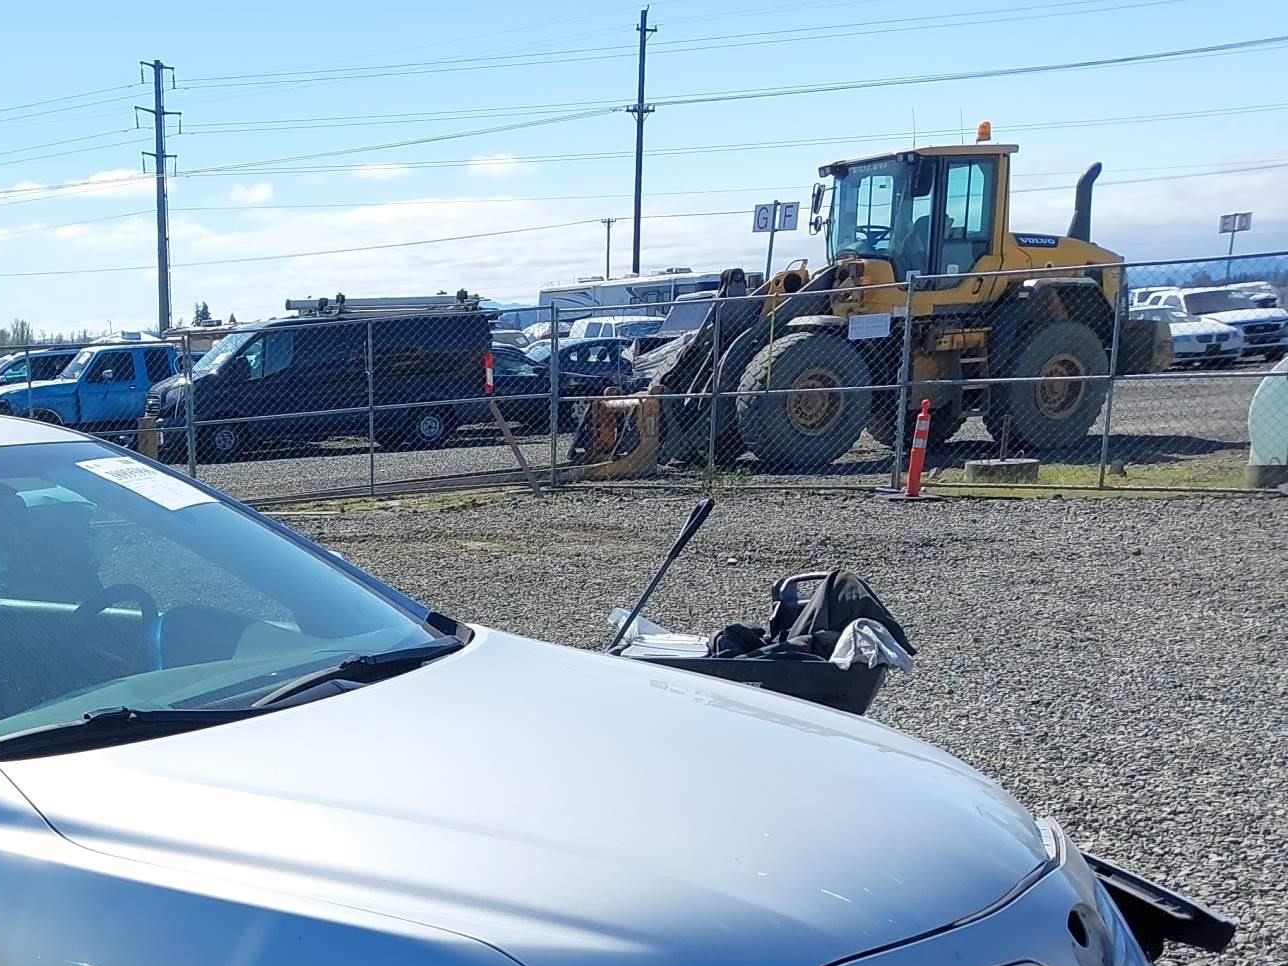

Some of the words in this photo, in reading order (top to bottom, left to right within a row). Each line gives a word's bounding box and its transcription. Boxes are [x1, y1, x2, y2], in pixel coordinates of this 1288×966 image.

[757, 206, 769, 230] G
[783, 204, 794, 229] F
[1019, 237, 1056, 245] VOLVO
